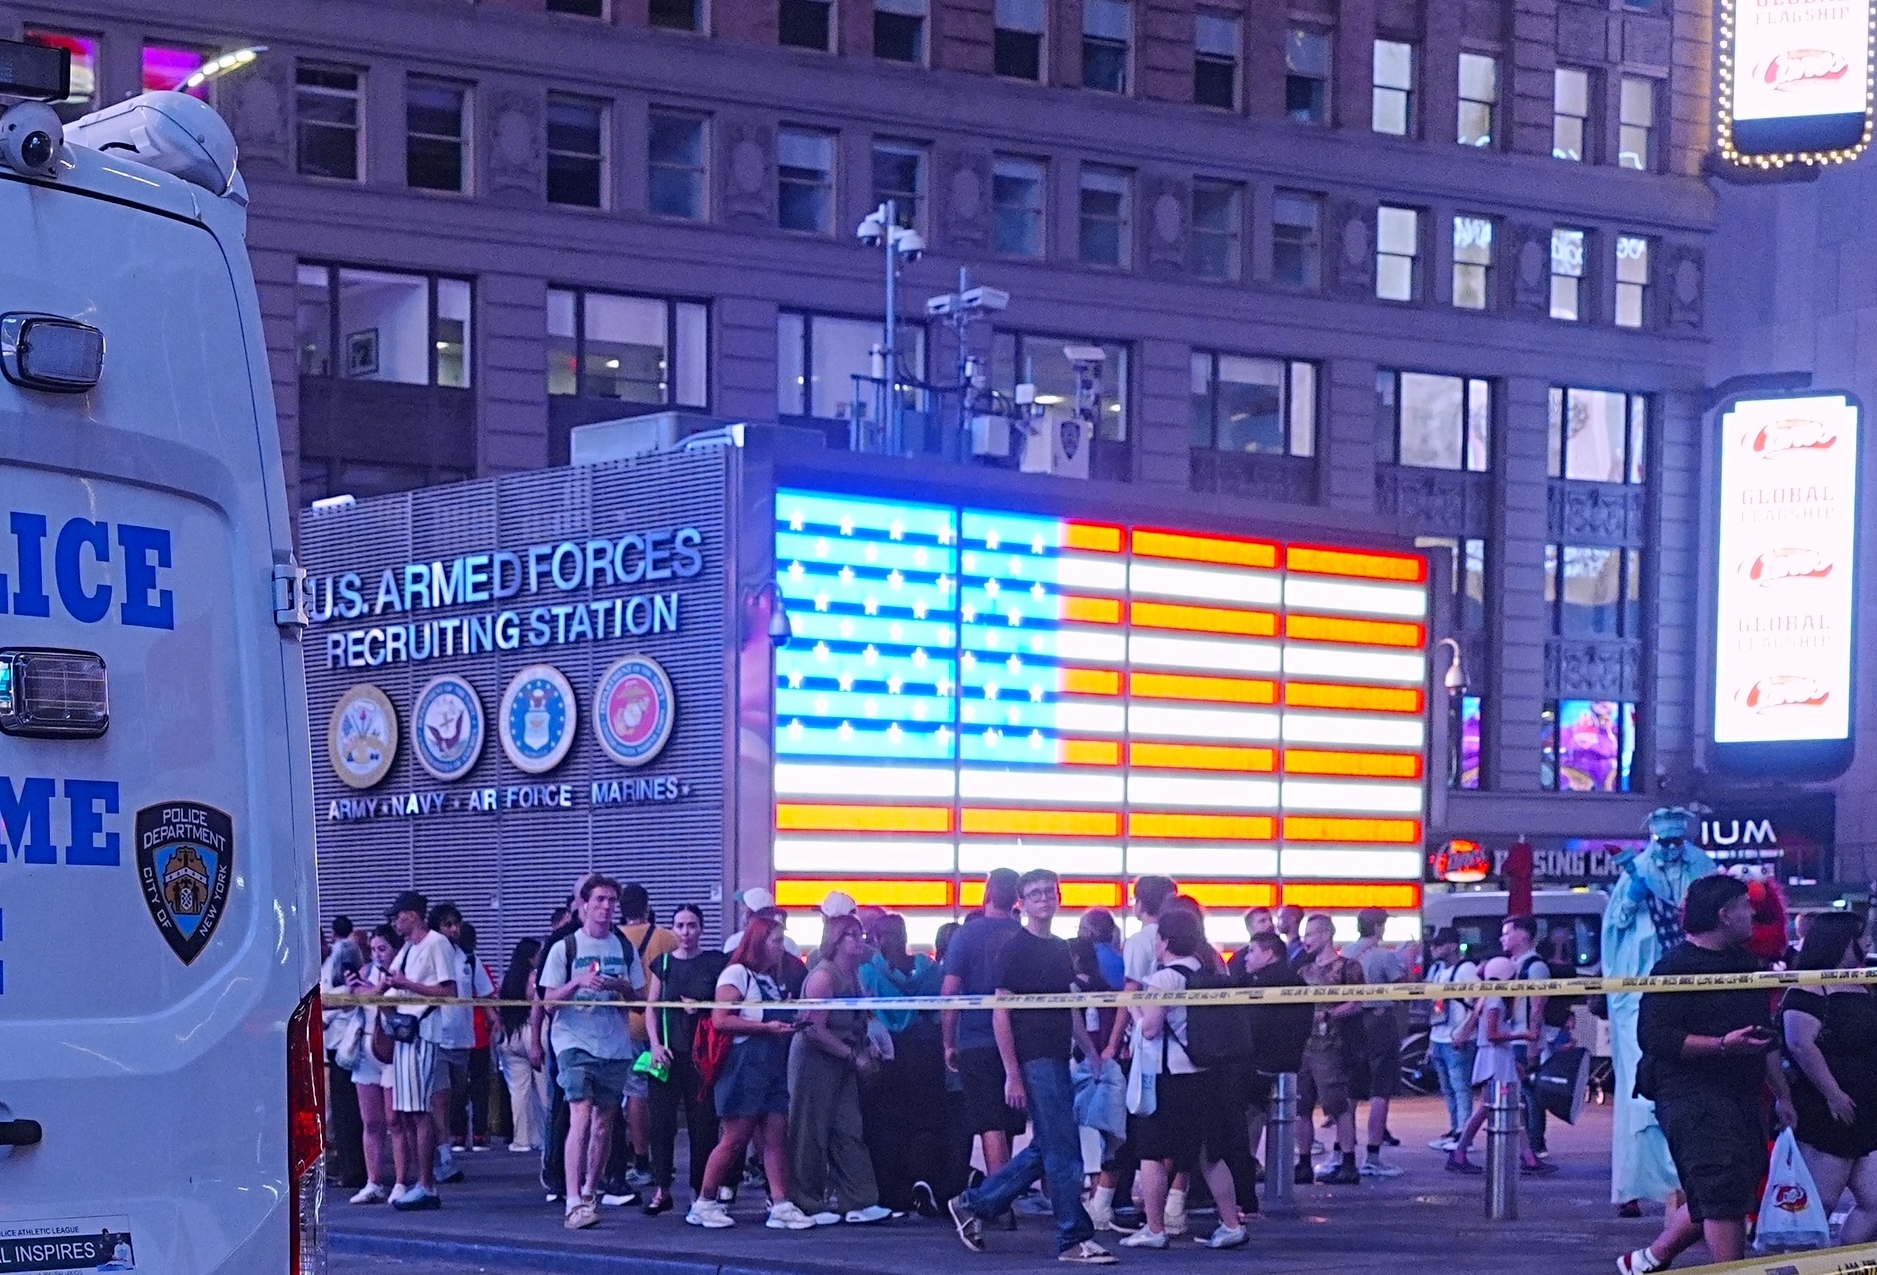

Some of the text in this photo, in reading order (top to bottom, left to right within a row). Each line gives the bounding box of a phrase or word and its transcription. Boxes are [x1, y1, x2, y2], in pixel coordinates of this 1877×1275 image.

[1742, 486, 1834, 505] GLOBAL
[309, 528, 703, 624] U.S. ARMED FORCES
[326, 592, 679, 669] RECRUITING STATION
[162, 808, 208, 826] POLICE
[328, 777, 679, 821] ARMY NAVY AIR FORCE MARINES
[143, 824, 226, 852] DEPARTMENT
[143, 867, 172, 929] CITY OF
[199, 865, 227, 936] NEW YORK
[17, 1228, 50, 1236] ATHLETIC
[52, 1226, 79, 1234] LEAGUE
[15, 1242, 96, 1263] INSPIRES
